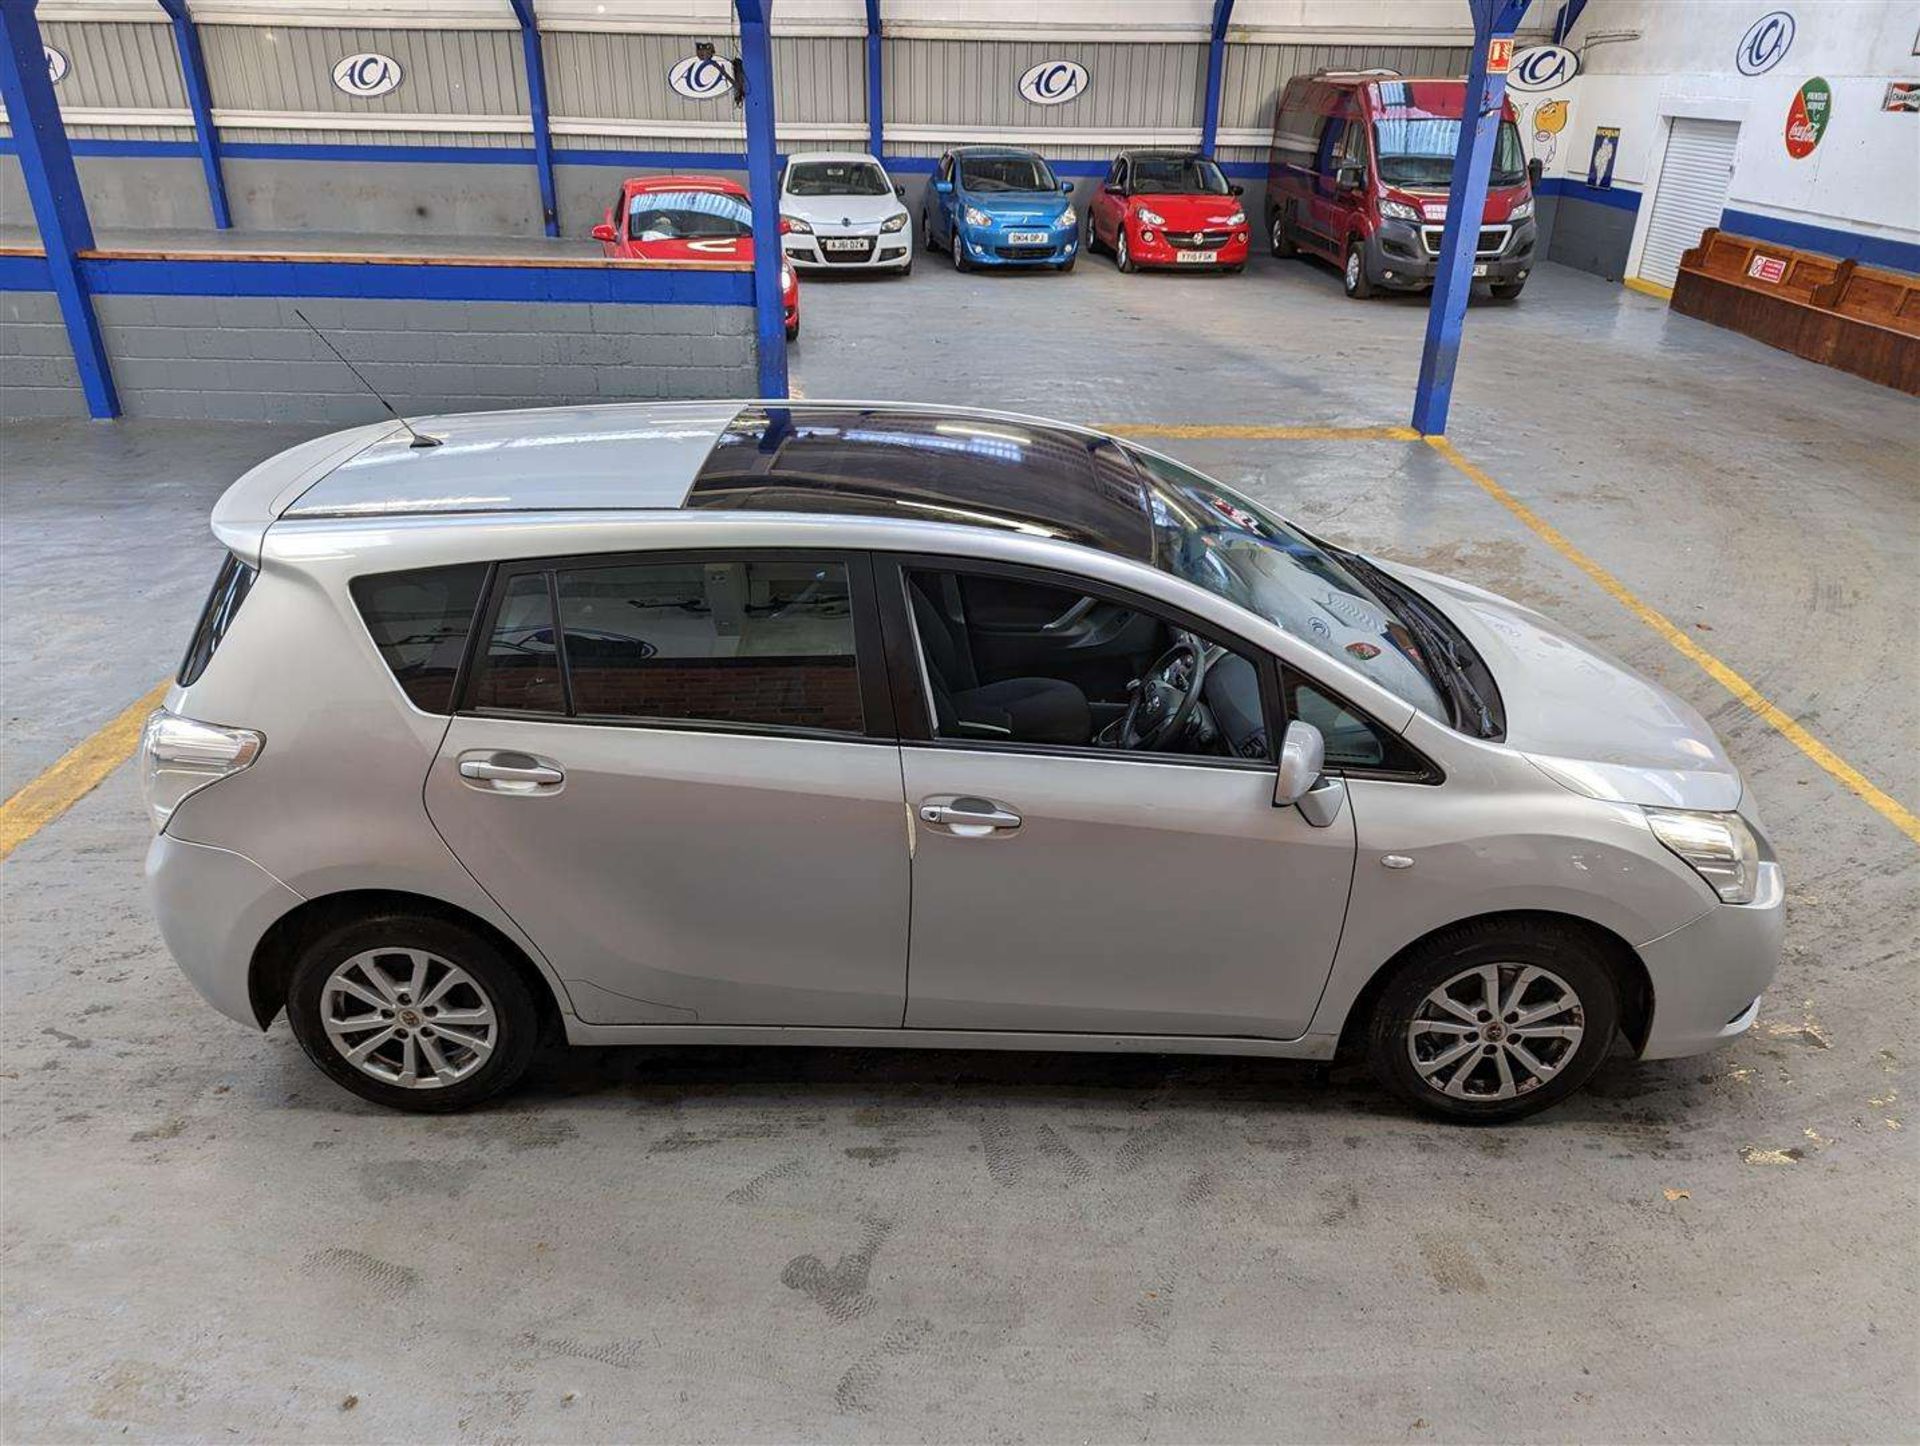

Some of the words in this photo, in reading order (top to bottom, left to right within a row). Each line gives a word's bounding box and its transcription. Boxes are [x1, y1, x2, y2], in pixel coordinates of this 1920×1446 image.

[1740, 18, 1785, 67] ACA
[338, 57, 393, 90] ACA
[674, 58, 729, 92] ACA
[1023, 65, 1077, 98] ACA
[1508, 50, 1565, 84] ACA
